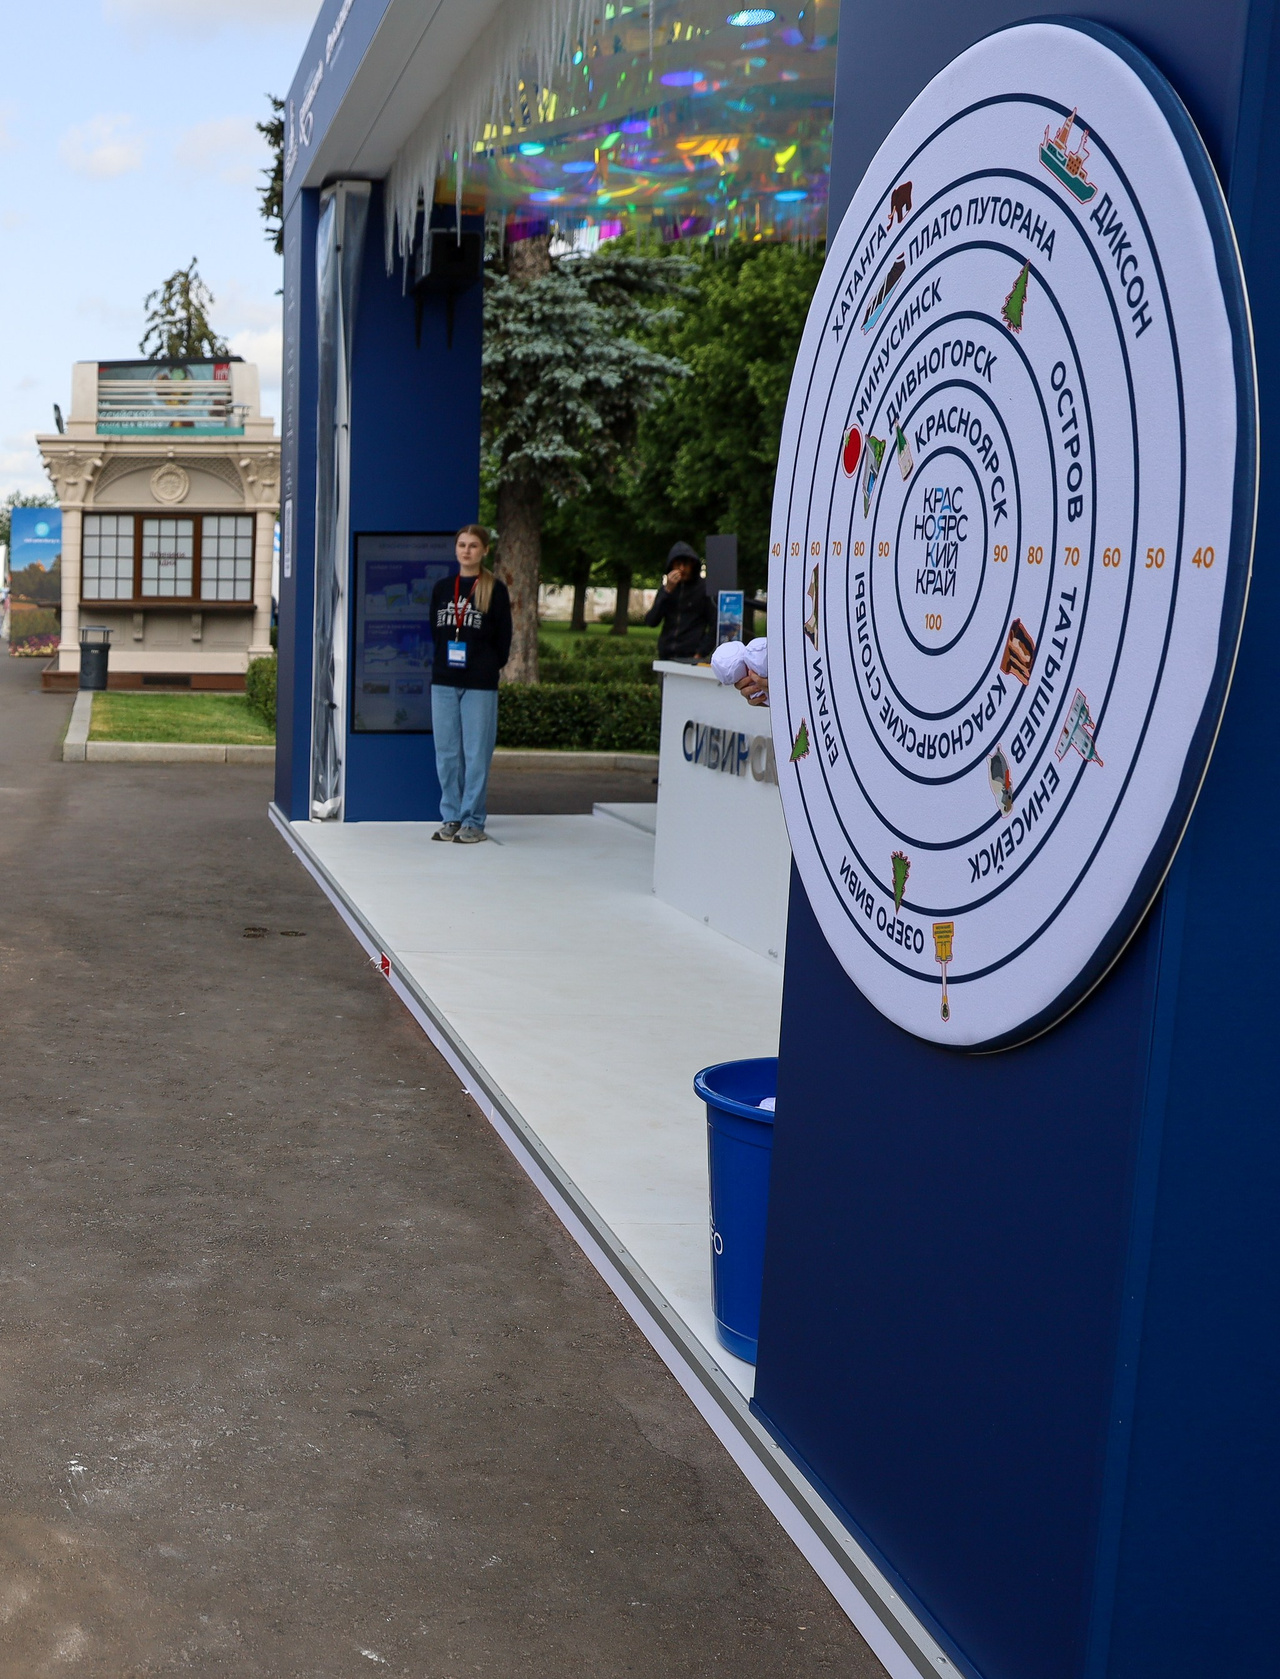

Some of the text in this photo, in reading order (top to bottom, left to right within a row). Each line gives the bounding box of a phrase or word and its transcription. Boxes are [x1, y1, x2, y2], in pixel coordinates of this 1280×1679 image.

[908, 195, 1056, 267] ПЛАТО ПУТОРАНА
[1089, 192, 1153, 339] ДИКСОН
[831, 222, 888, 344] ХАТАНГА
[854, 275, 943, 427] МИНУСИНСК
[885, 339, 998, 437] ДИВНОГОРСК
[914, 405, 1008, 528] КРАСНОЯРСК
[923, 486, 964, 514] КРАС
[771, 541, 890, 557] 40 50 60 70 80 90
[913, 514, 969, 542] НОЯРС
[925, 540, 959, 570] КИЙ
[993, 544, 1215, 569] 90 80 70 60 50 40
[1010, 360, 1084, 765] ОСТРОВ ТАТЫШЕВ
[915, 568, 957, 597] КРАЙ
[925, 613, 943, 631] 100
[812, 656, 840, 768] ЕРГАКИ
[854, 571, 1008, 760] КРАСНОЯРСКИЕ СТОЛБЫ
[967, 761, 1061, 884] ЕНИСЕЙСК
[839, 855, 925, 955] ОЗЕРО ВИВИ
